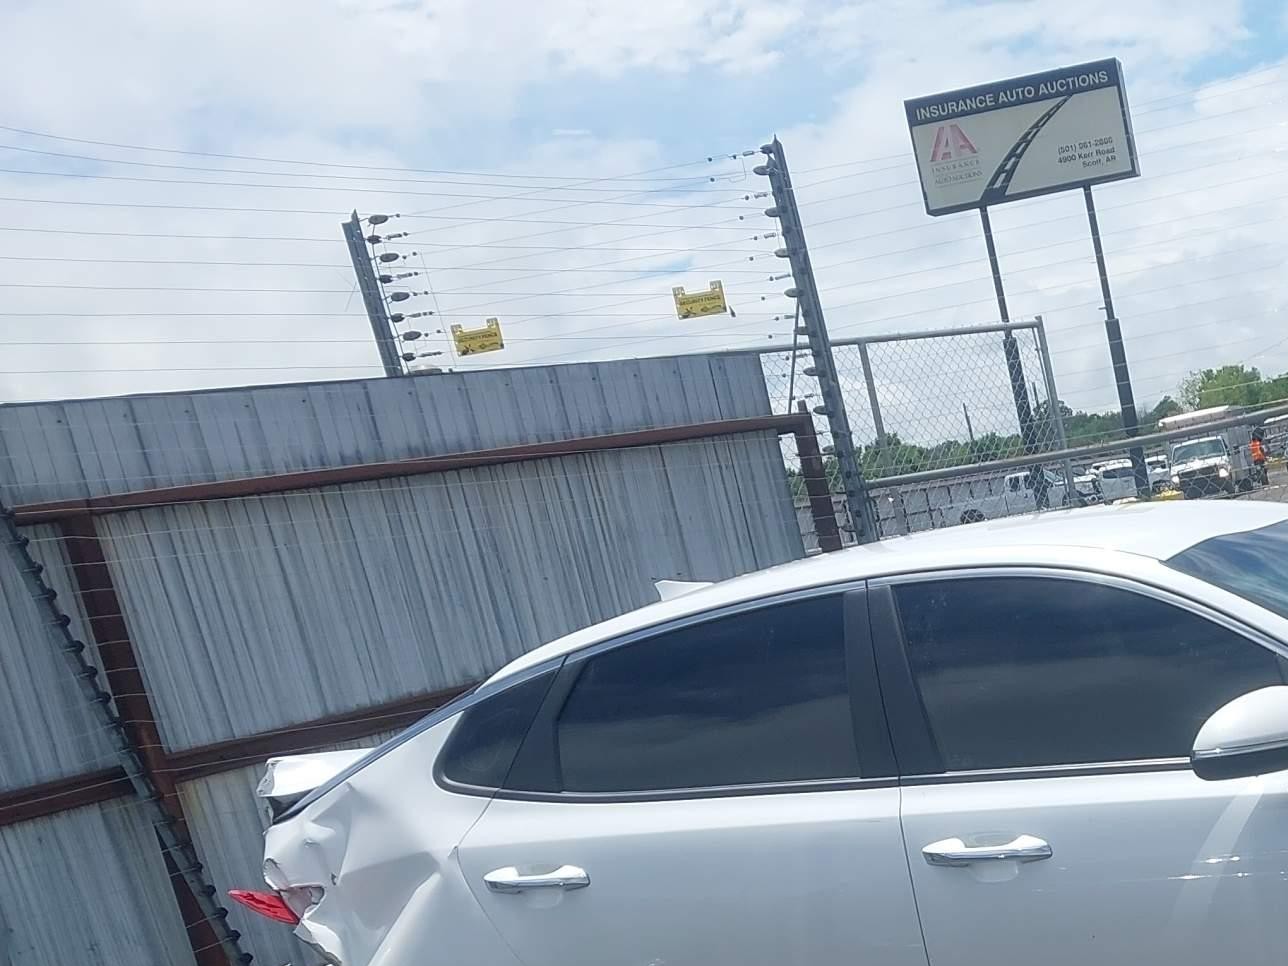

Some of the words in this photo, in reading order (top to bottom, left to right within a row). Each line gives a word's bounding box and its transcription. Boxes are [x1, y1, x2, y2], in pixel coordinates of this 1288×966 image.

[916, 94, 995, 120] INSURANCE
[998, 86, 1035, 104] AUTO
[1039, 71, 1109, 96] AUCTIONS
